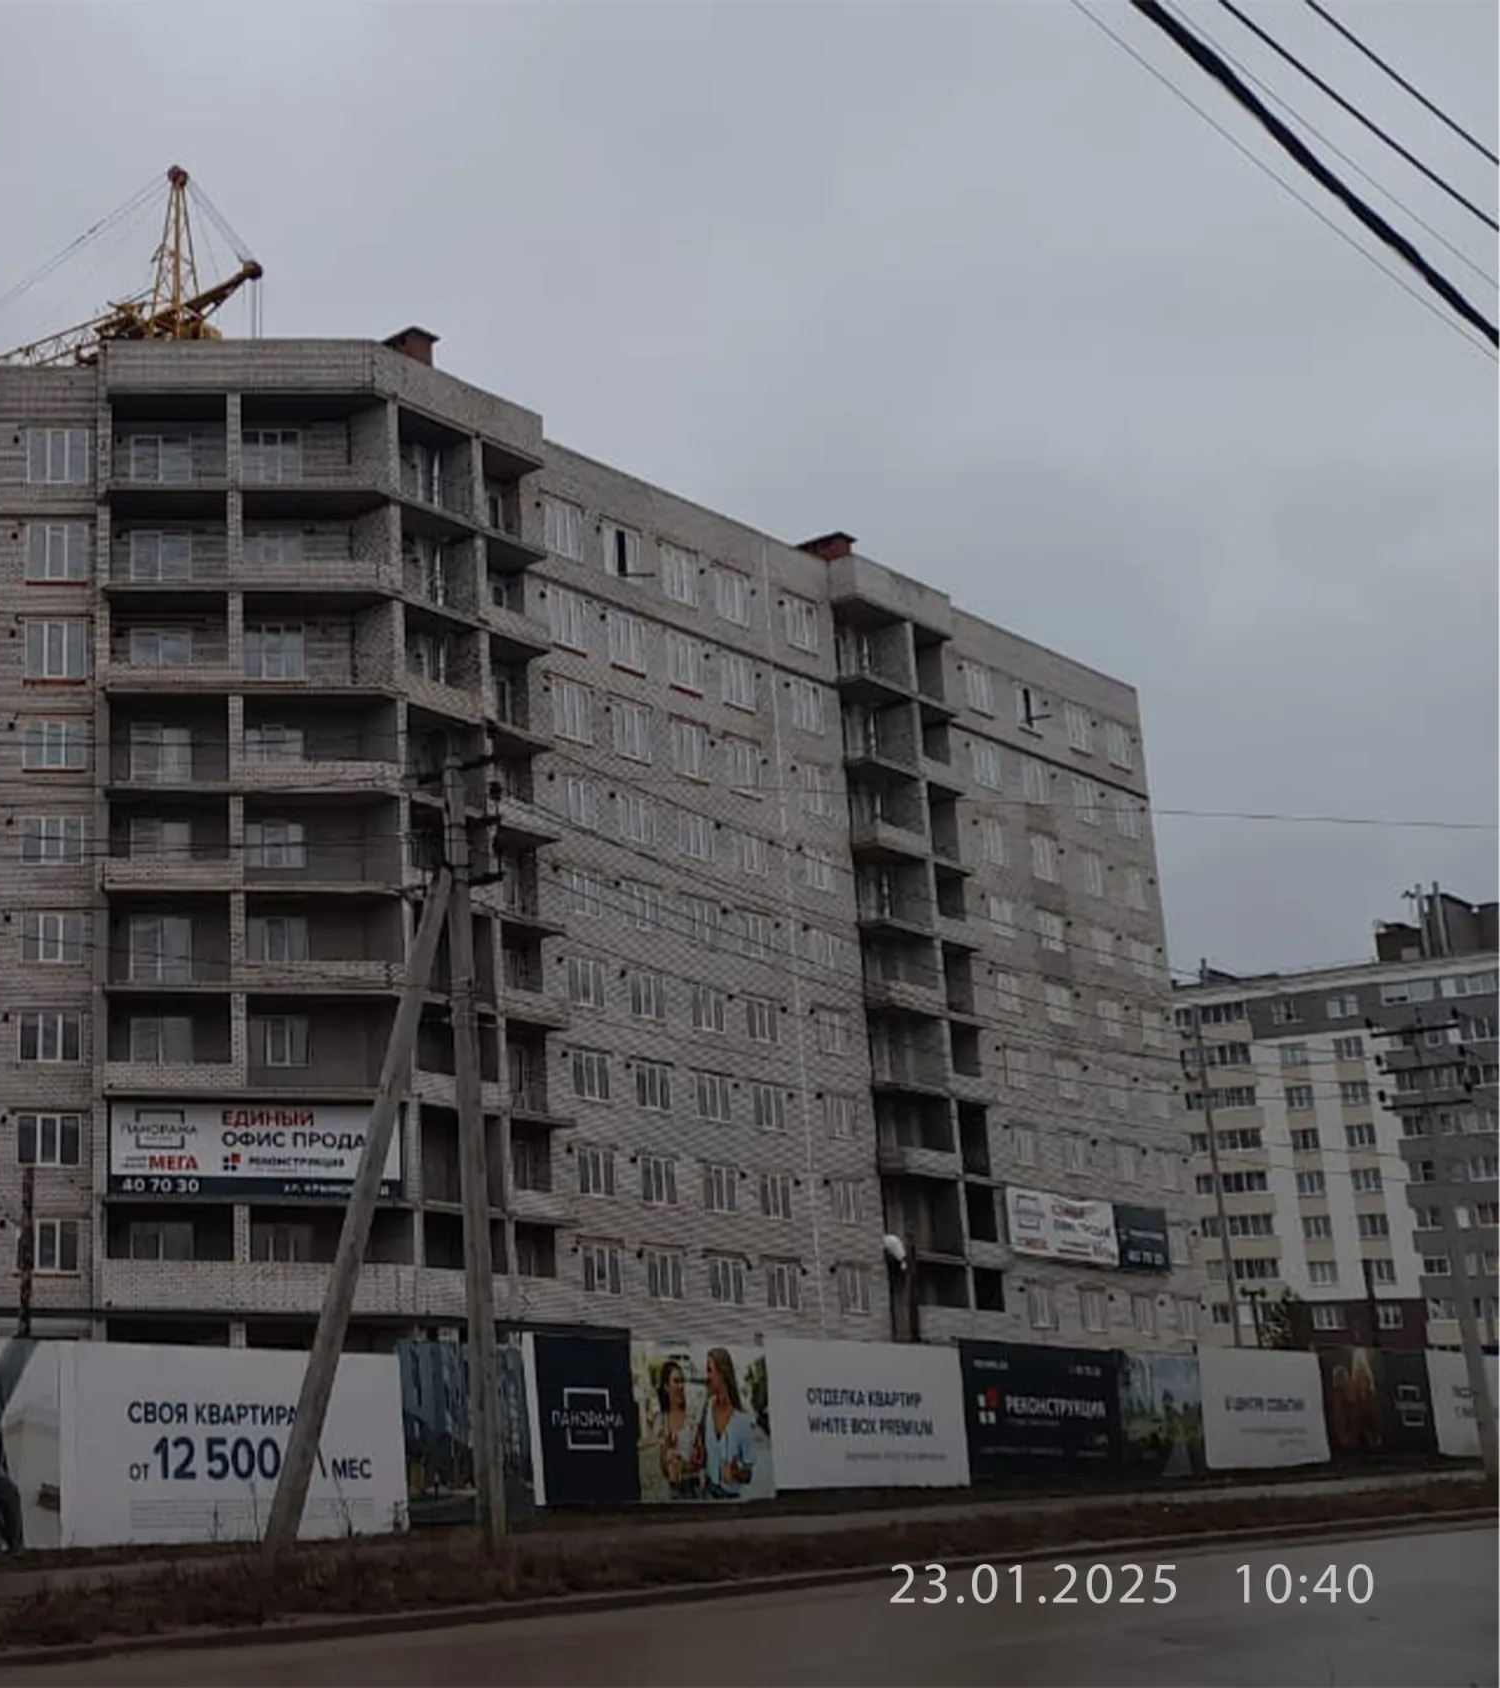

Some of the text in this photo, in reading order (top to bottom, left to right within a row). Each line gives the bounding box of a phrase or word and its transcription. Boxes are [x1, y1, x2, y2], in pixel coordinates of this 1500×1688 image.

[222, 1109, 314, 1127] ЕДИНЫЙ
[221, 1131, 367, 1150] ОФИС ПРОДА
[148, 1154, 199, 1171] МЕГА
[122, 1178, 200, 1192] 40 70 30
[807, 1388, 921, 1409] ОТДЕЛКА КВАРТИР
[127, 1401, 188, 1425] СВОЯ
[551, 1410, 625, 1428] ПАНОРАМА
[807, 1414, 933, 1437] WHITE BOX PREMIUM
